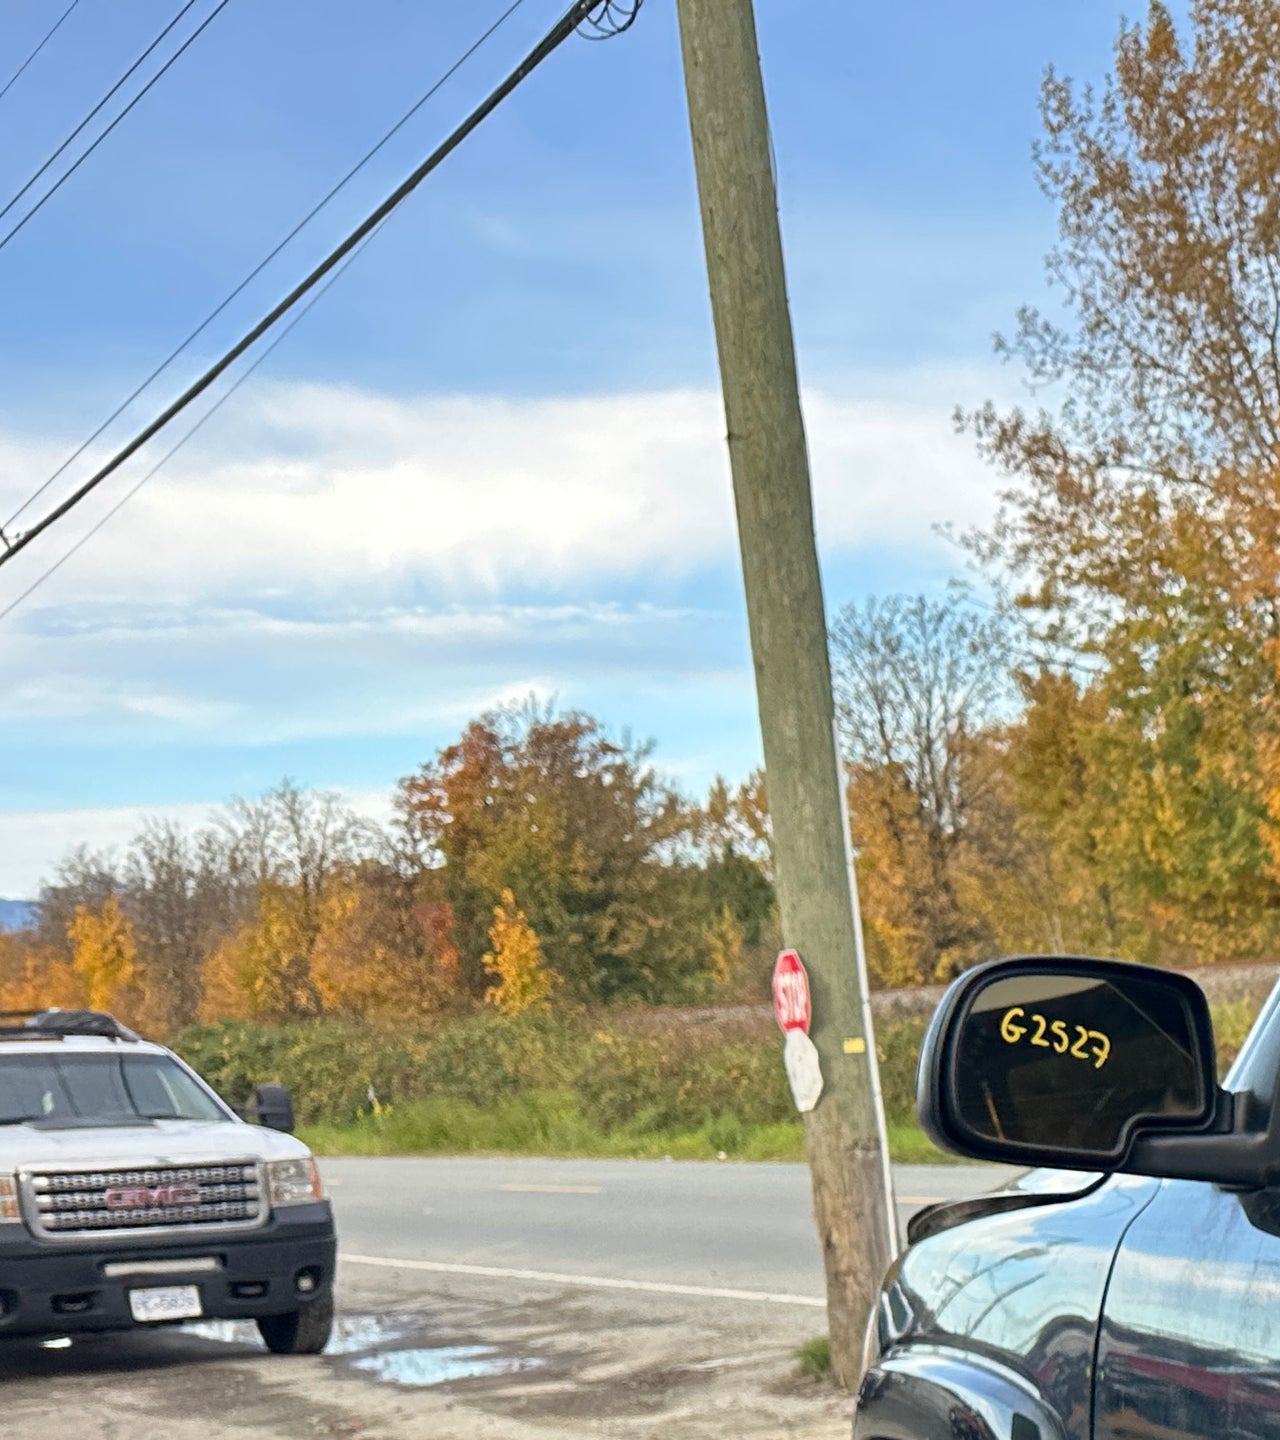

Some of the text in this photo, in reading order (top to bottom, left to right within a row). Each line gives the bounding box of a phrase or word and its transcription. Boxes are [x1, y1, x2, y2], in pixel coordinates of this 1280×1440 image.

[776, 972, 808, 1023] STOP
[1000, 1006, 1111, 1069] G2527
[105, 1183, 201, 1210] GMC
